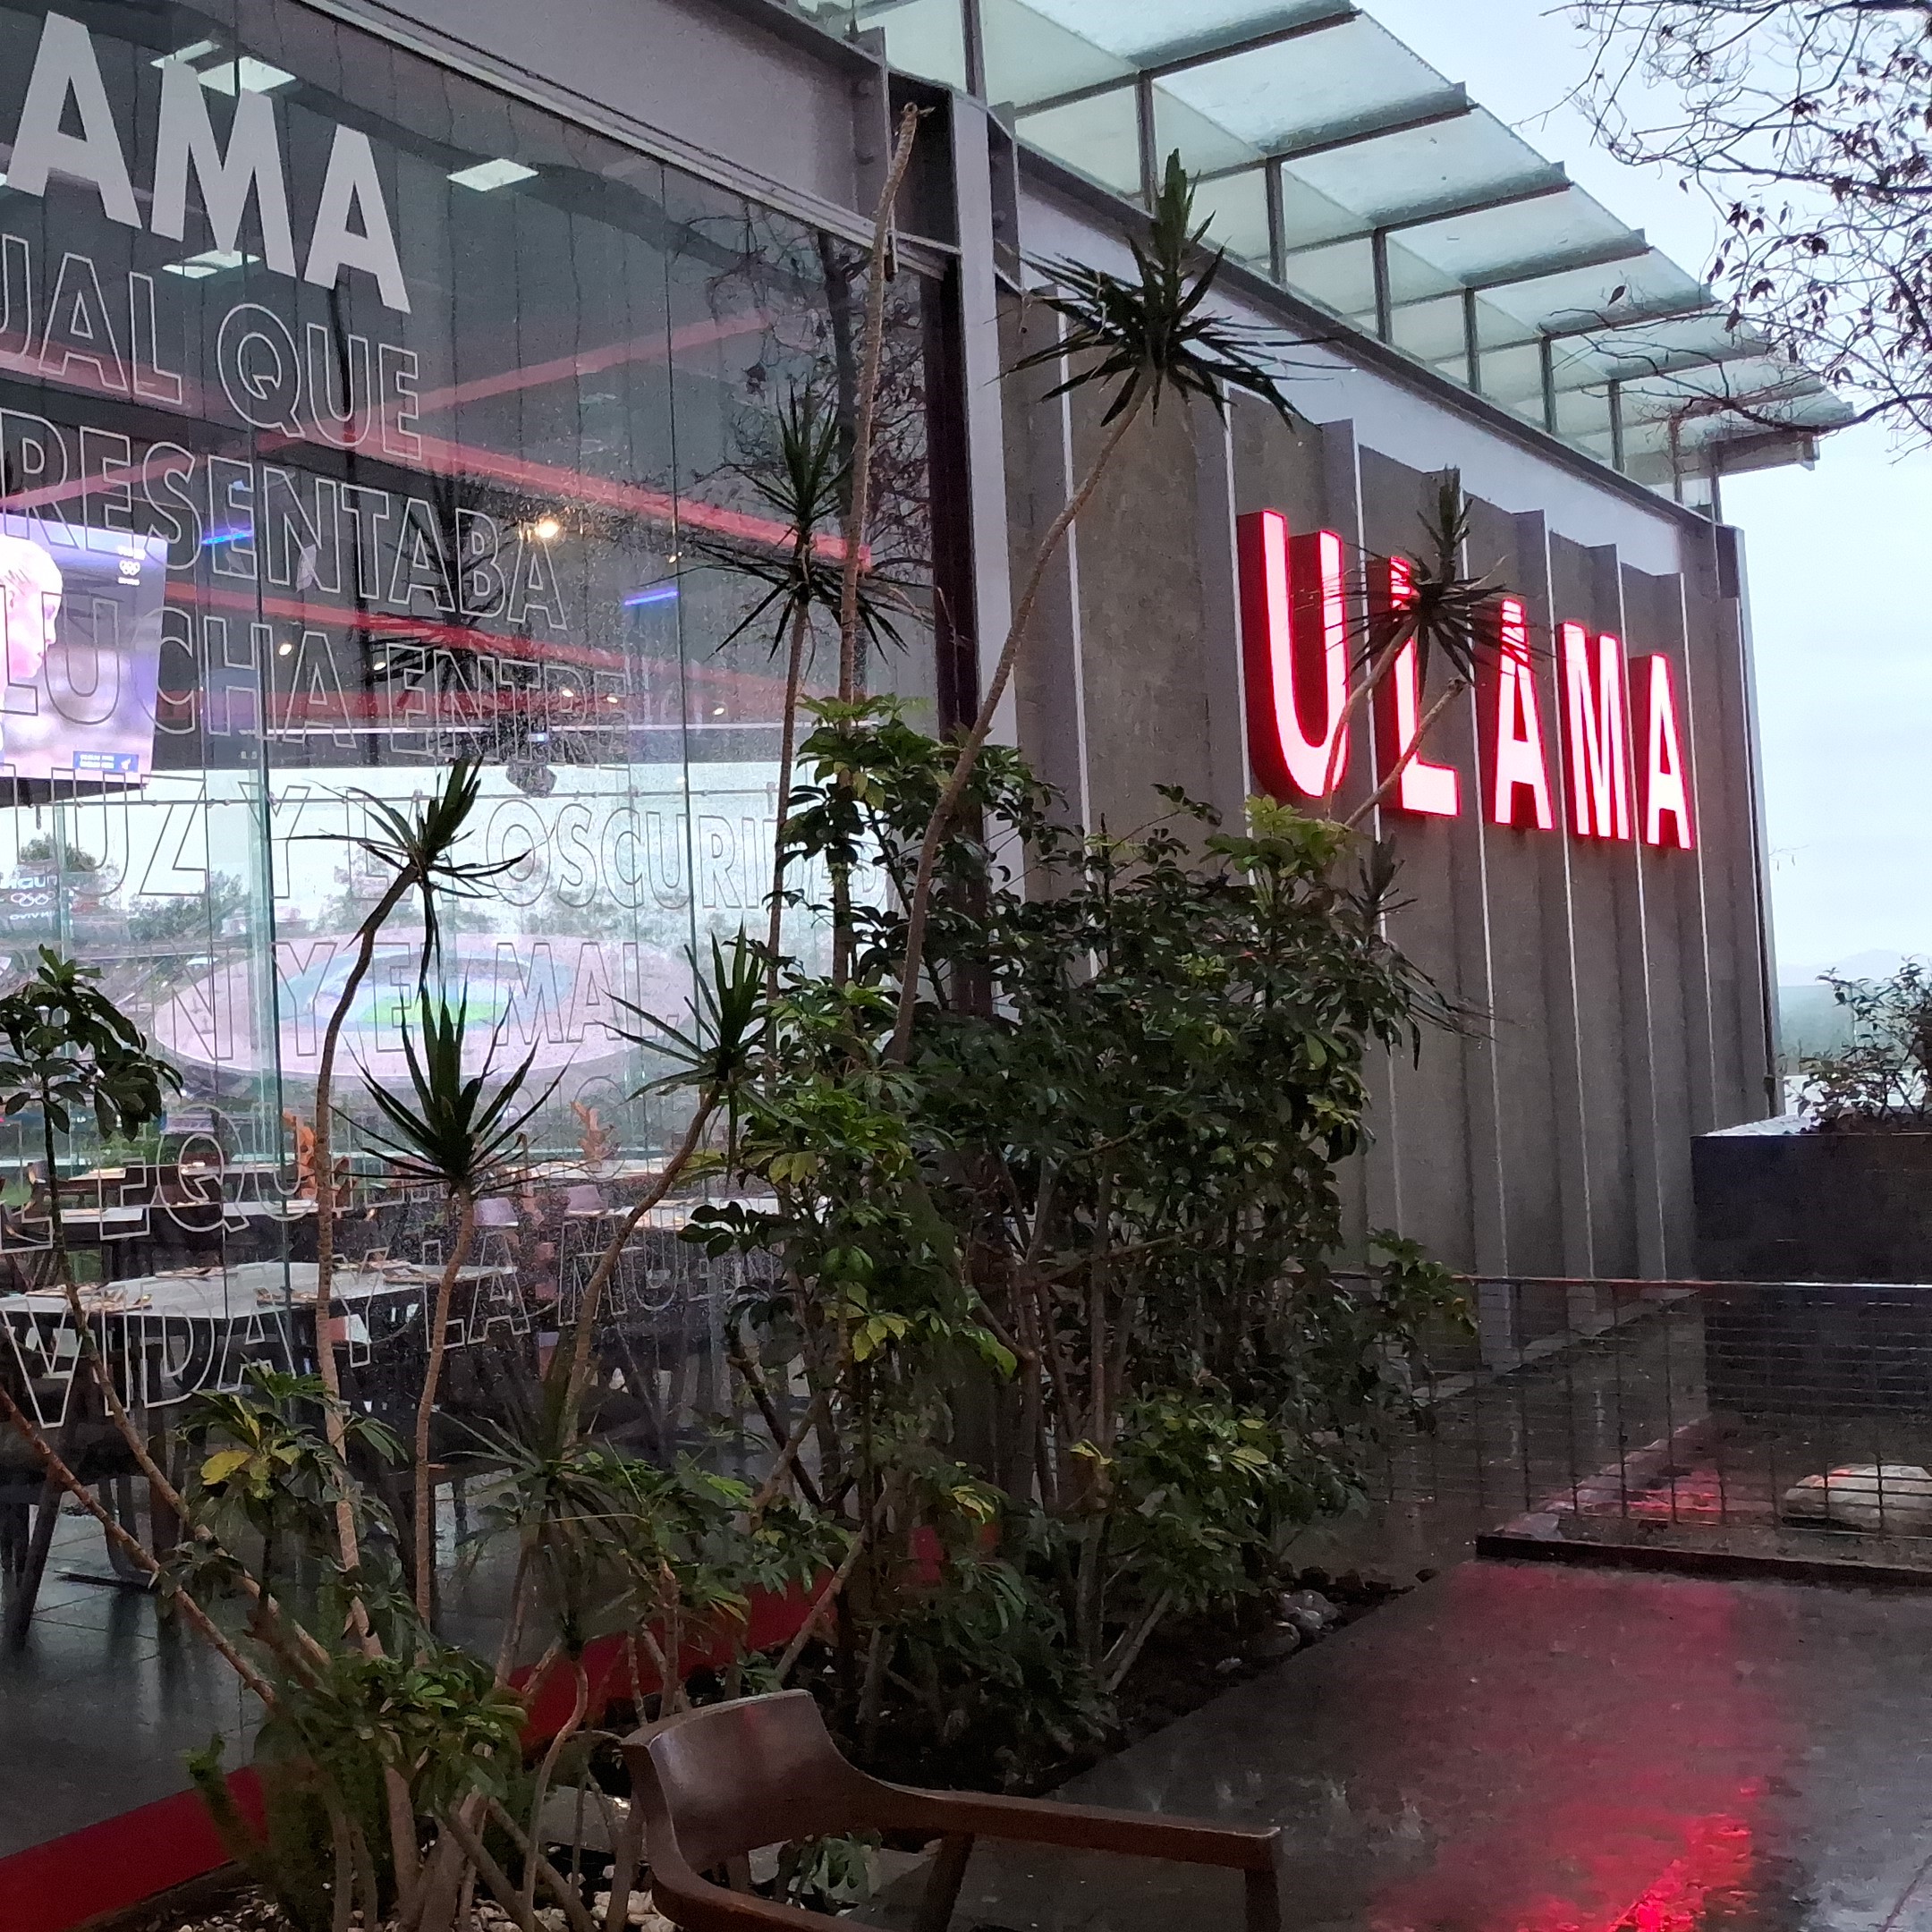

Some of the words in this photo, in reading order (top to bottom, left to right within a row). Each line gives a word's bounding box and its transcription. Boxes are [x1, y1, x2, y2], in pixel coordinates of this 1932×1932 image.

[6, 10, 411, 314] AMA
[216, 303, 421, 462] QUE
[0, 408, 568, 630] RESENTABA
[0, 583, 358, 750] LUCHA
[386, 643, 631, 772] ENTRE
[1237, 509, 1693, 851] ULAMA
[238, 781, 311, 899] Y
[271, 942, 338, 1057] Y
[0, 1269, 300, 1428] VIDA
[422, 1230, 531, 1352] LA
